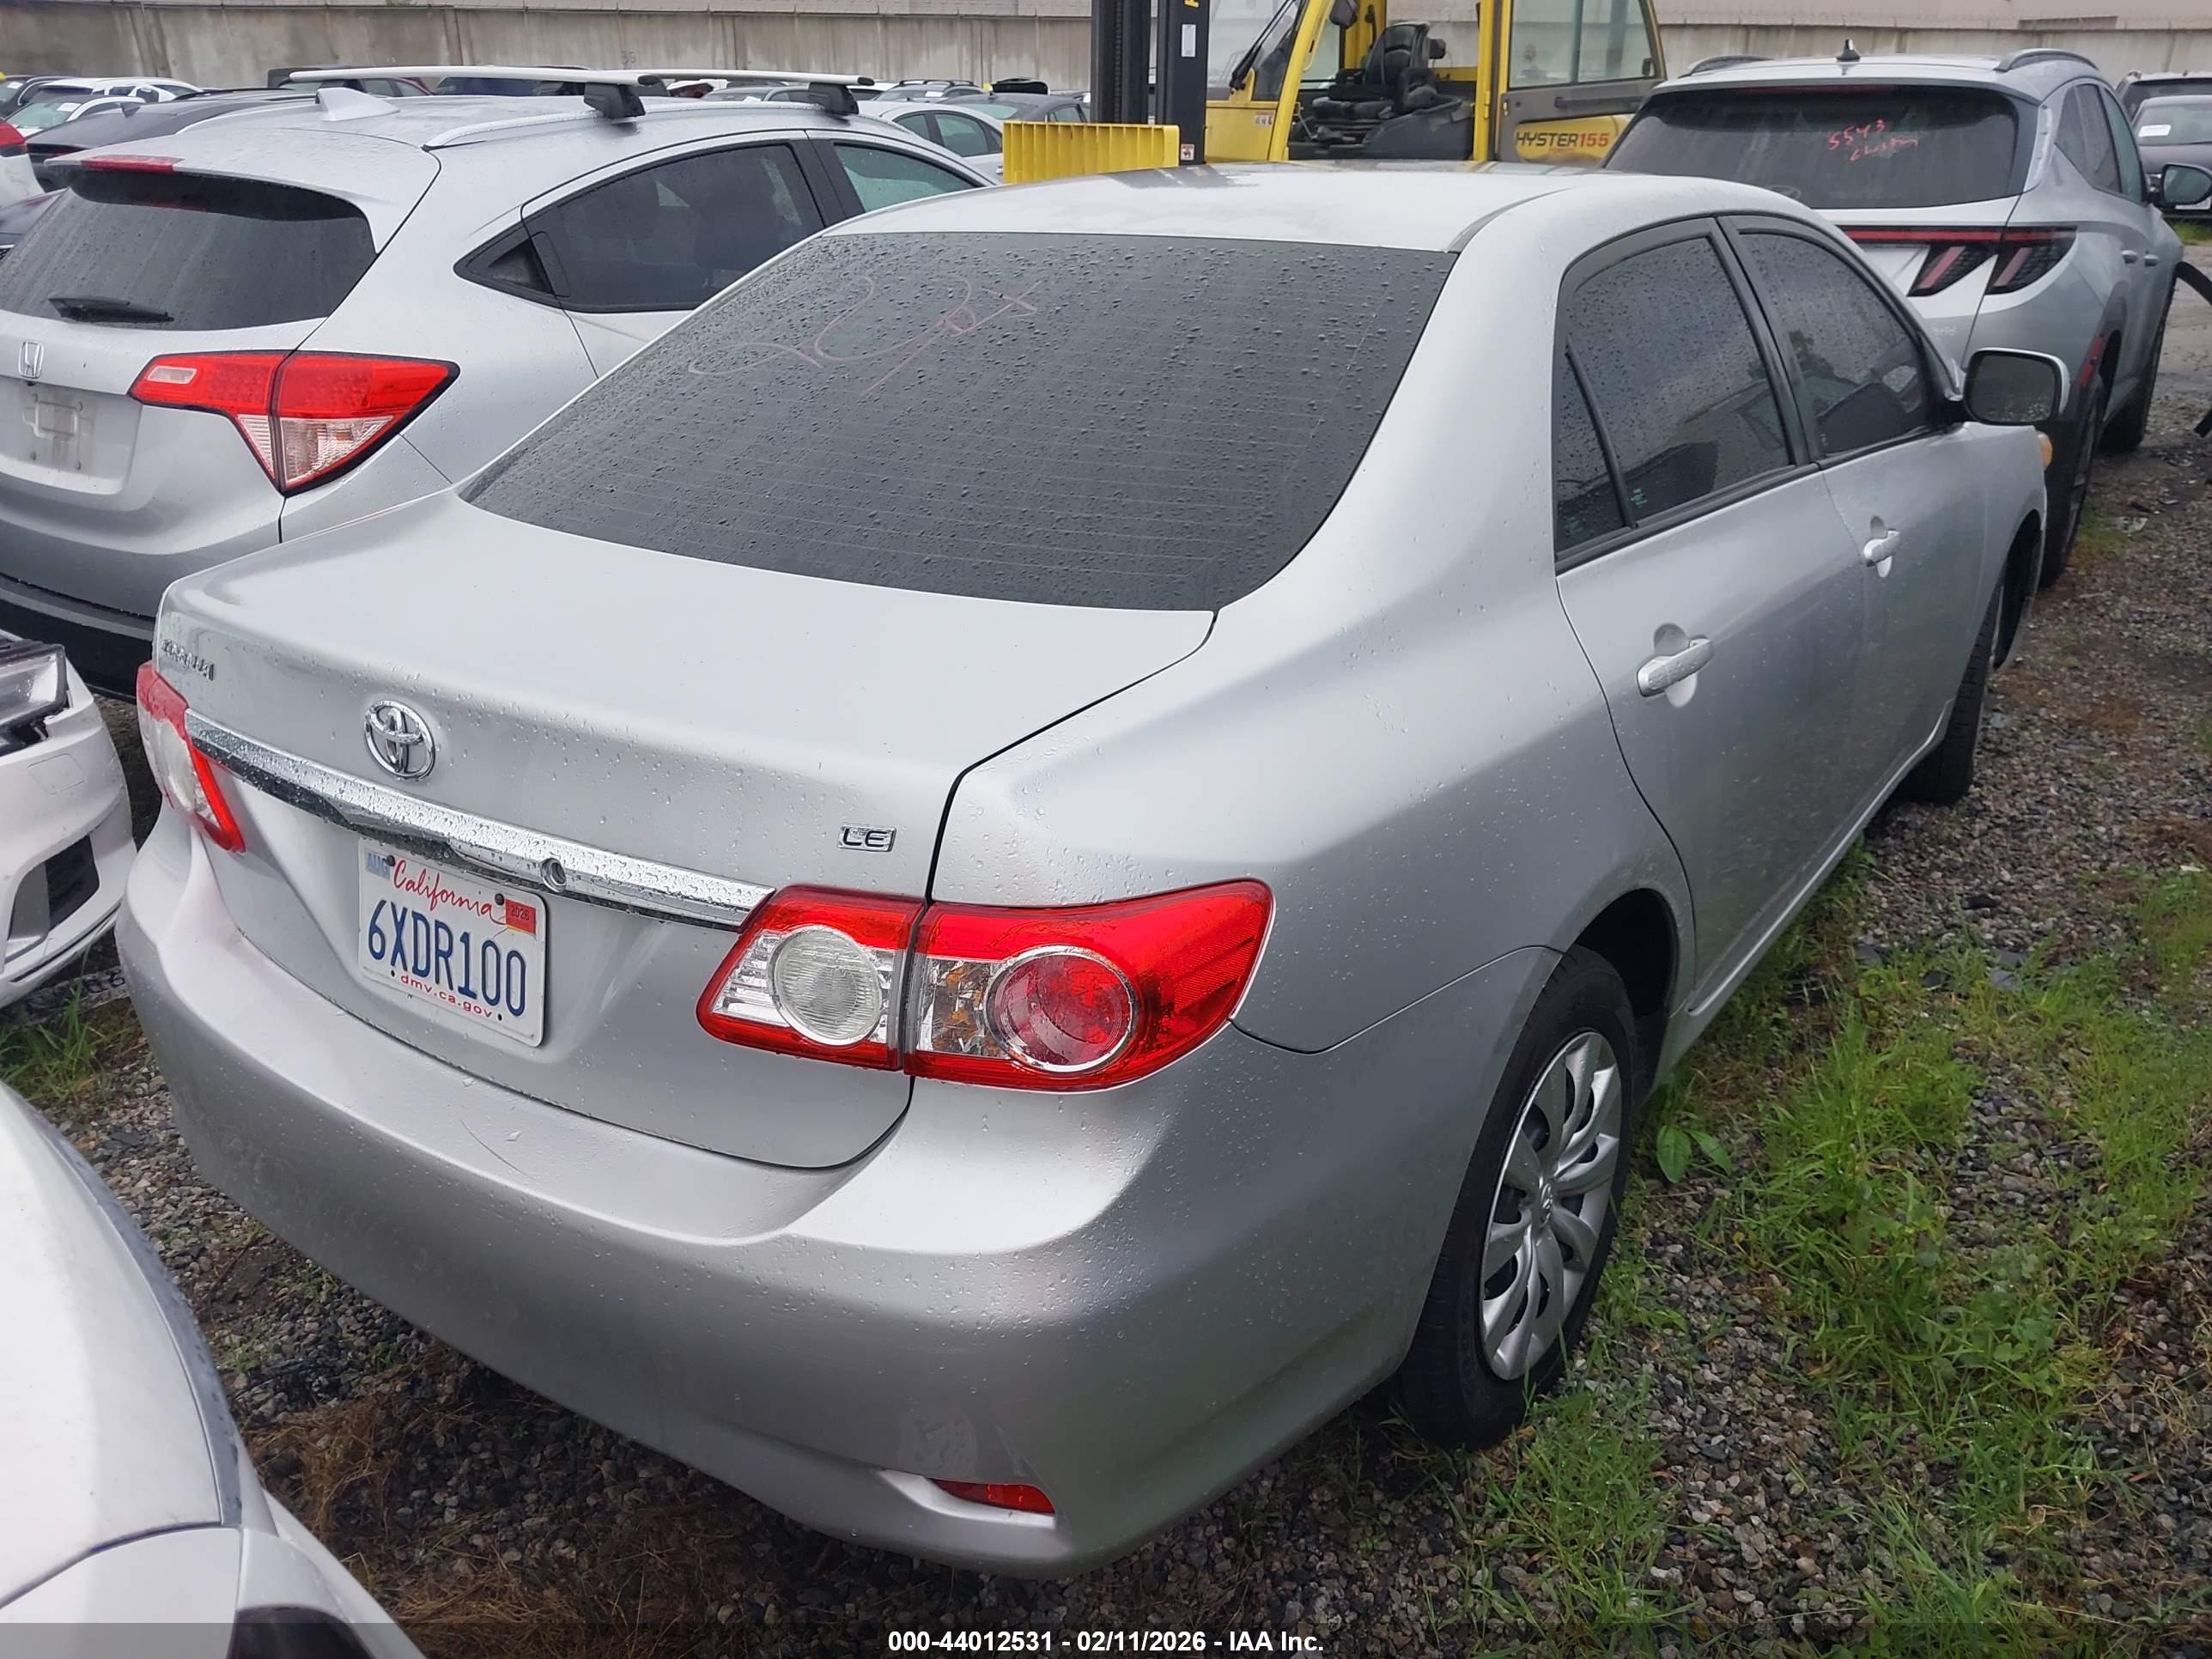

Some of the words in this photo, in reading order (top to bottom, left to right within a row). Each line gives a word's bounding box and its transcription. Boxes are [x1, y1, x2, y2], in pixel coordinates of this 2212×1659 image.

[842, 828, 888, 848] LE
[393, 860, 507, 926] California
[368, 899, 527, 1018] 6XDR100
[400, 974, 494, 1018] dmv.ca.gov
